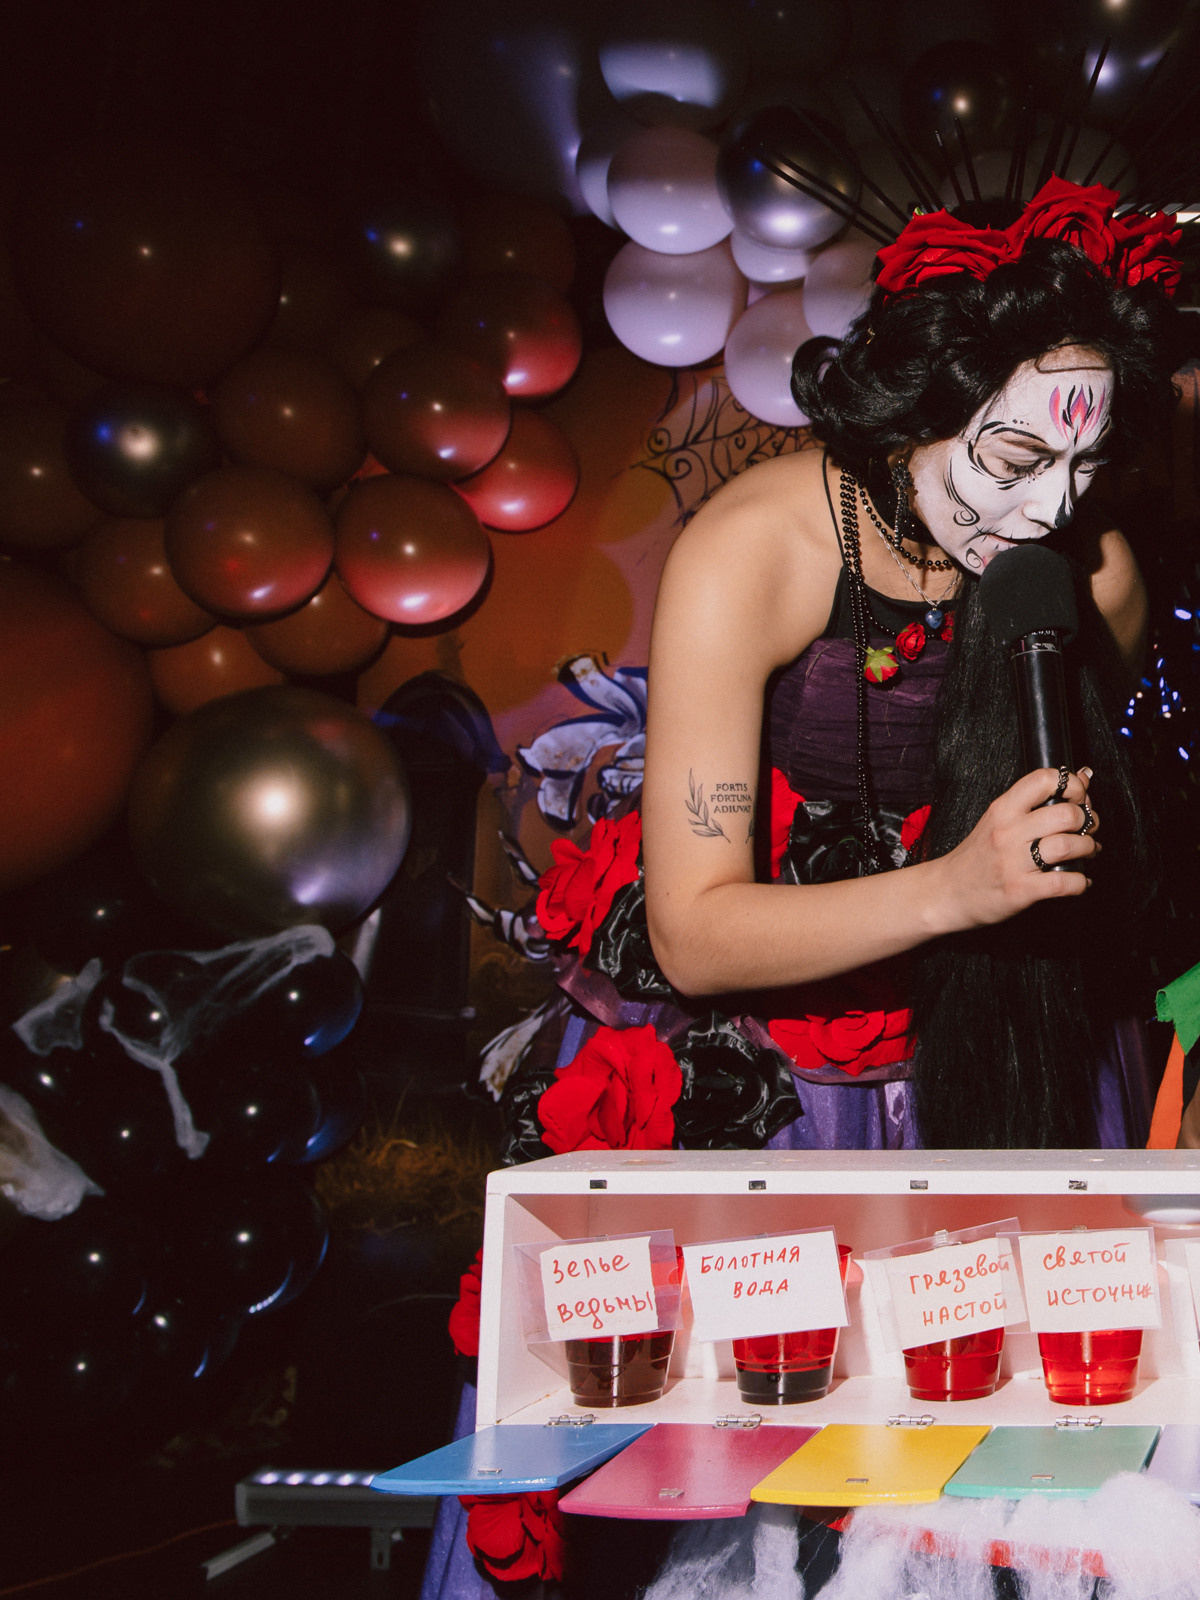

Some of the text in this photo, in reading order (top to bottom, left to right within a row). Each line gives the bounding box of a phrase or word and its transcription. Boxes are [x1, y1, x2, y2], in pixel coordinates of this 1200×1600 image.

[716, 783, 748, 792] FORTIS
[710, 794, 752, 802] FORTUNA
[713, 805, 751, 813] ADIUVAT
[700, 1246, 801, 1274] БОЛОТНАЯ
[733, 1279, 789, 1299] ВОДА
